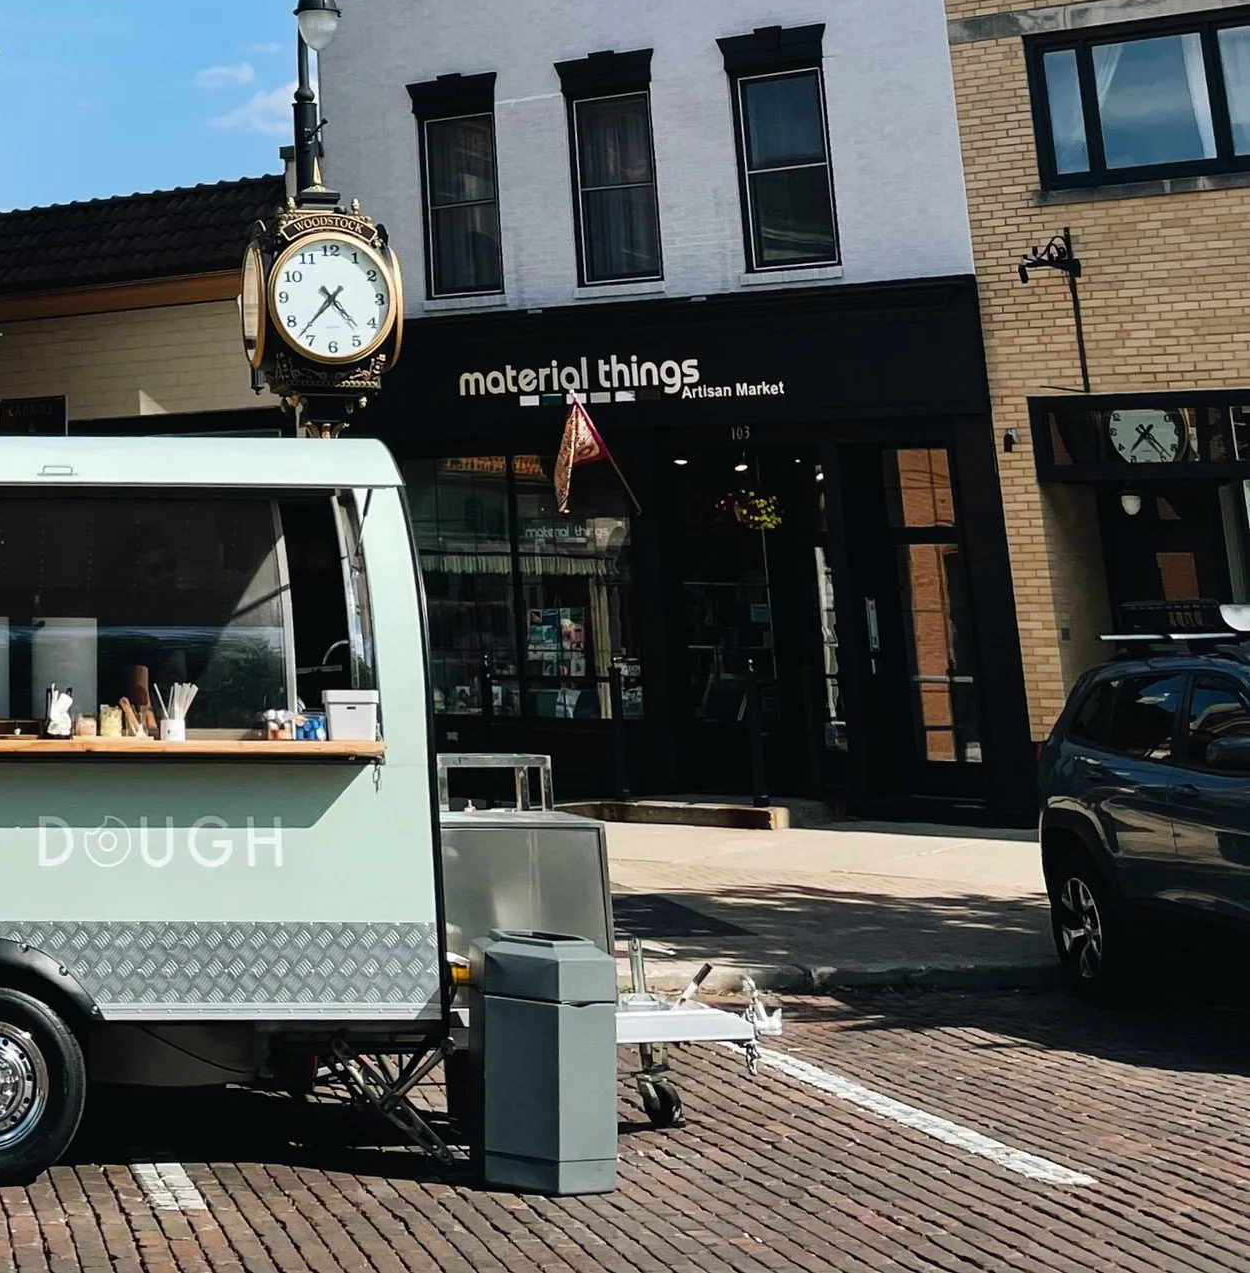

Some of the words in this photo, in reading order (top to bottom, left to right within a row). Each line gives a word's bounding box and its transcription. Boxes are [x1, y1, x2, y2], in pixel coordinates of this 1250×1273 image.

[293, 216, 364, 234] WOODSTOCK
[321, 244, 340, 257] 12
[299, 253, 316, 264] 11
[351, 252, 359, 264] 1
[284, 271, 303, 282] 10
[367, 270, 377, 282] 2
[278, 291, 289, 304] 9
[374, 293, 385, 306] 3
[287, 315, 297, 327] 8
[367, 317, 378, 329] 4
[305, 335, 316, 347] 7
[328, 341, 338, 354] 6
[352, 335, 362, 348] 5
[459, 356, 588, 396] material
[598, 354, 700, 394] things
[682, 384, 732, 399] Artisan
[736, 380, 785, 397] Market
[730, 425, 751, 441] 103
